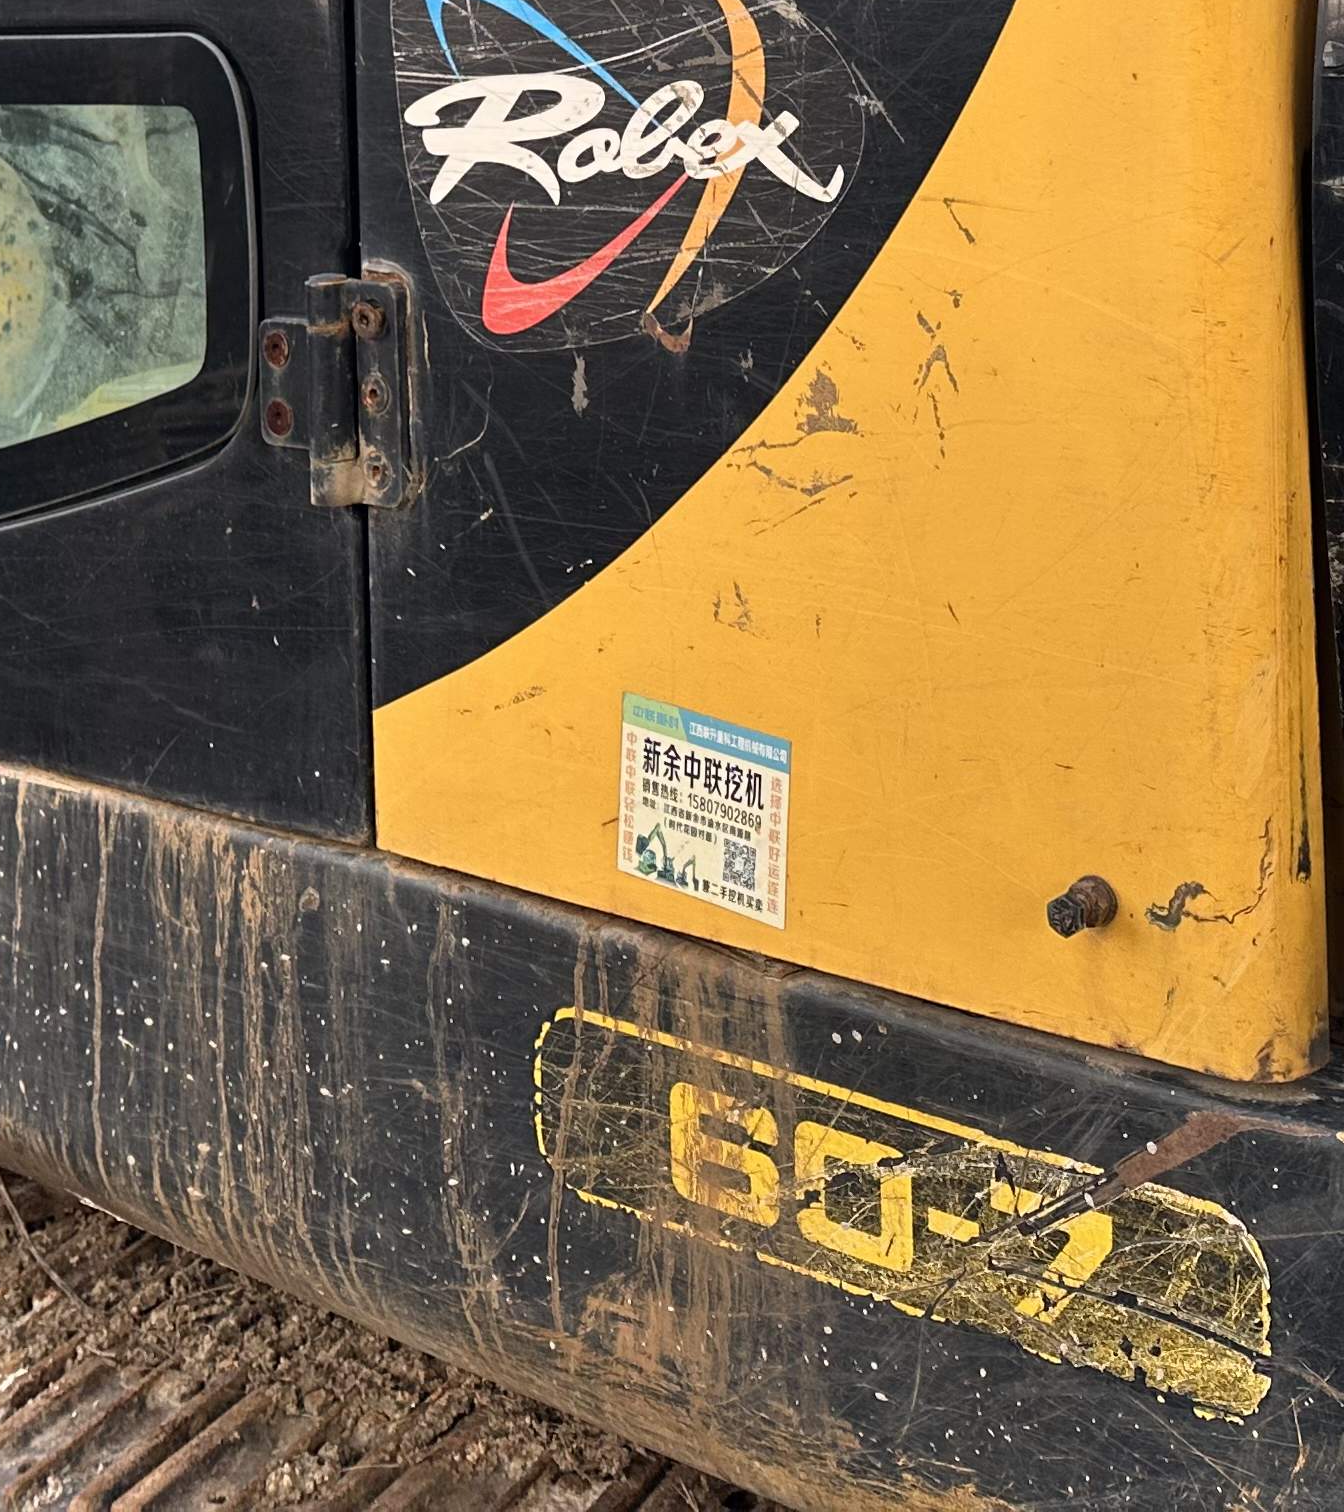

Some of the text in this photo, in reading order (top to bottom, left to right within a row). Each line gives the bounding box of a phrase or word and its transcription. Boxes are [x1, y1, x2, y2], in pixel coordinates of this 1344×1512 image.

[404, 72, 845, 206] Robex
[642, 737, 764, 810] 新余中联挖机
